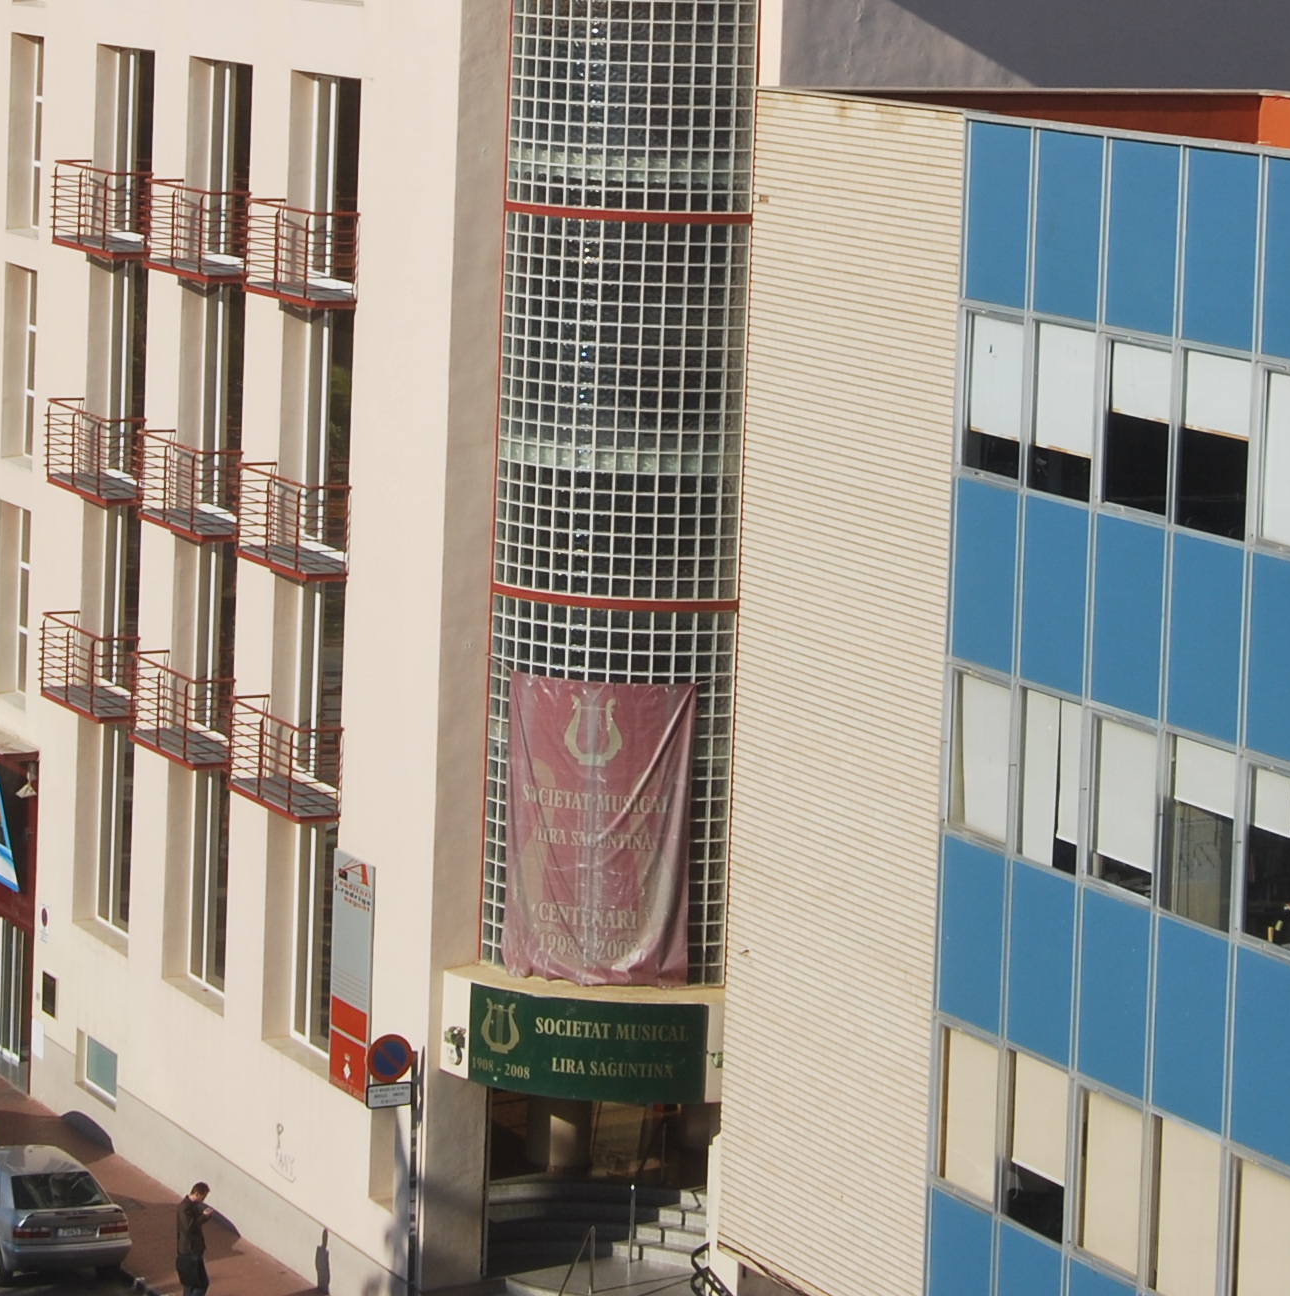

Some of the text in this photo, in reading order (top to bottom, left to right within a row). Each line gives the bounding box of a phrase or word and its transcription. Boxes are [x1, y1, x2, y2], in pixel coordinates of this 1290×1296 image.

[522, 784, 670, 814] SOCIETAT MUSICAL
[537, 826, 653, 851] LIRA SAGUNTINA
[538, 902, 638, 930] CENTENARI
[538, 932, 577, 956] 1908
[535, 1016, 688, 1042] SOCIETAT MUSICAL
[471, 1056, 494, 1072] 1908
[504, 1063, 530, 1079] 2008
[552, 1057, 673, 1078] LIRA SAGUNTINA
